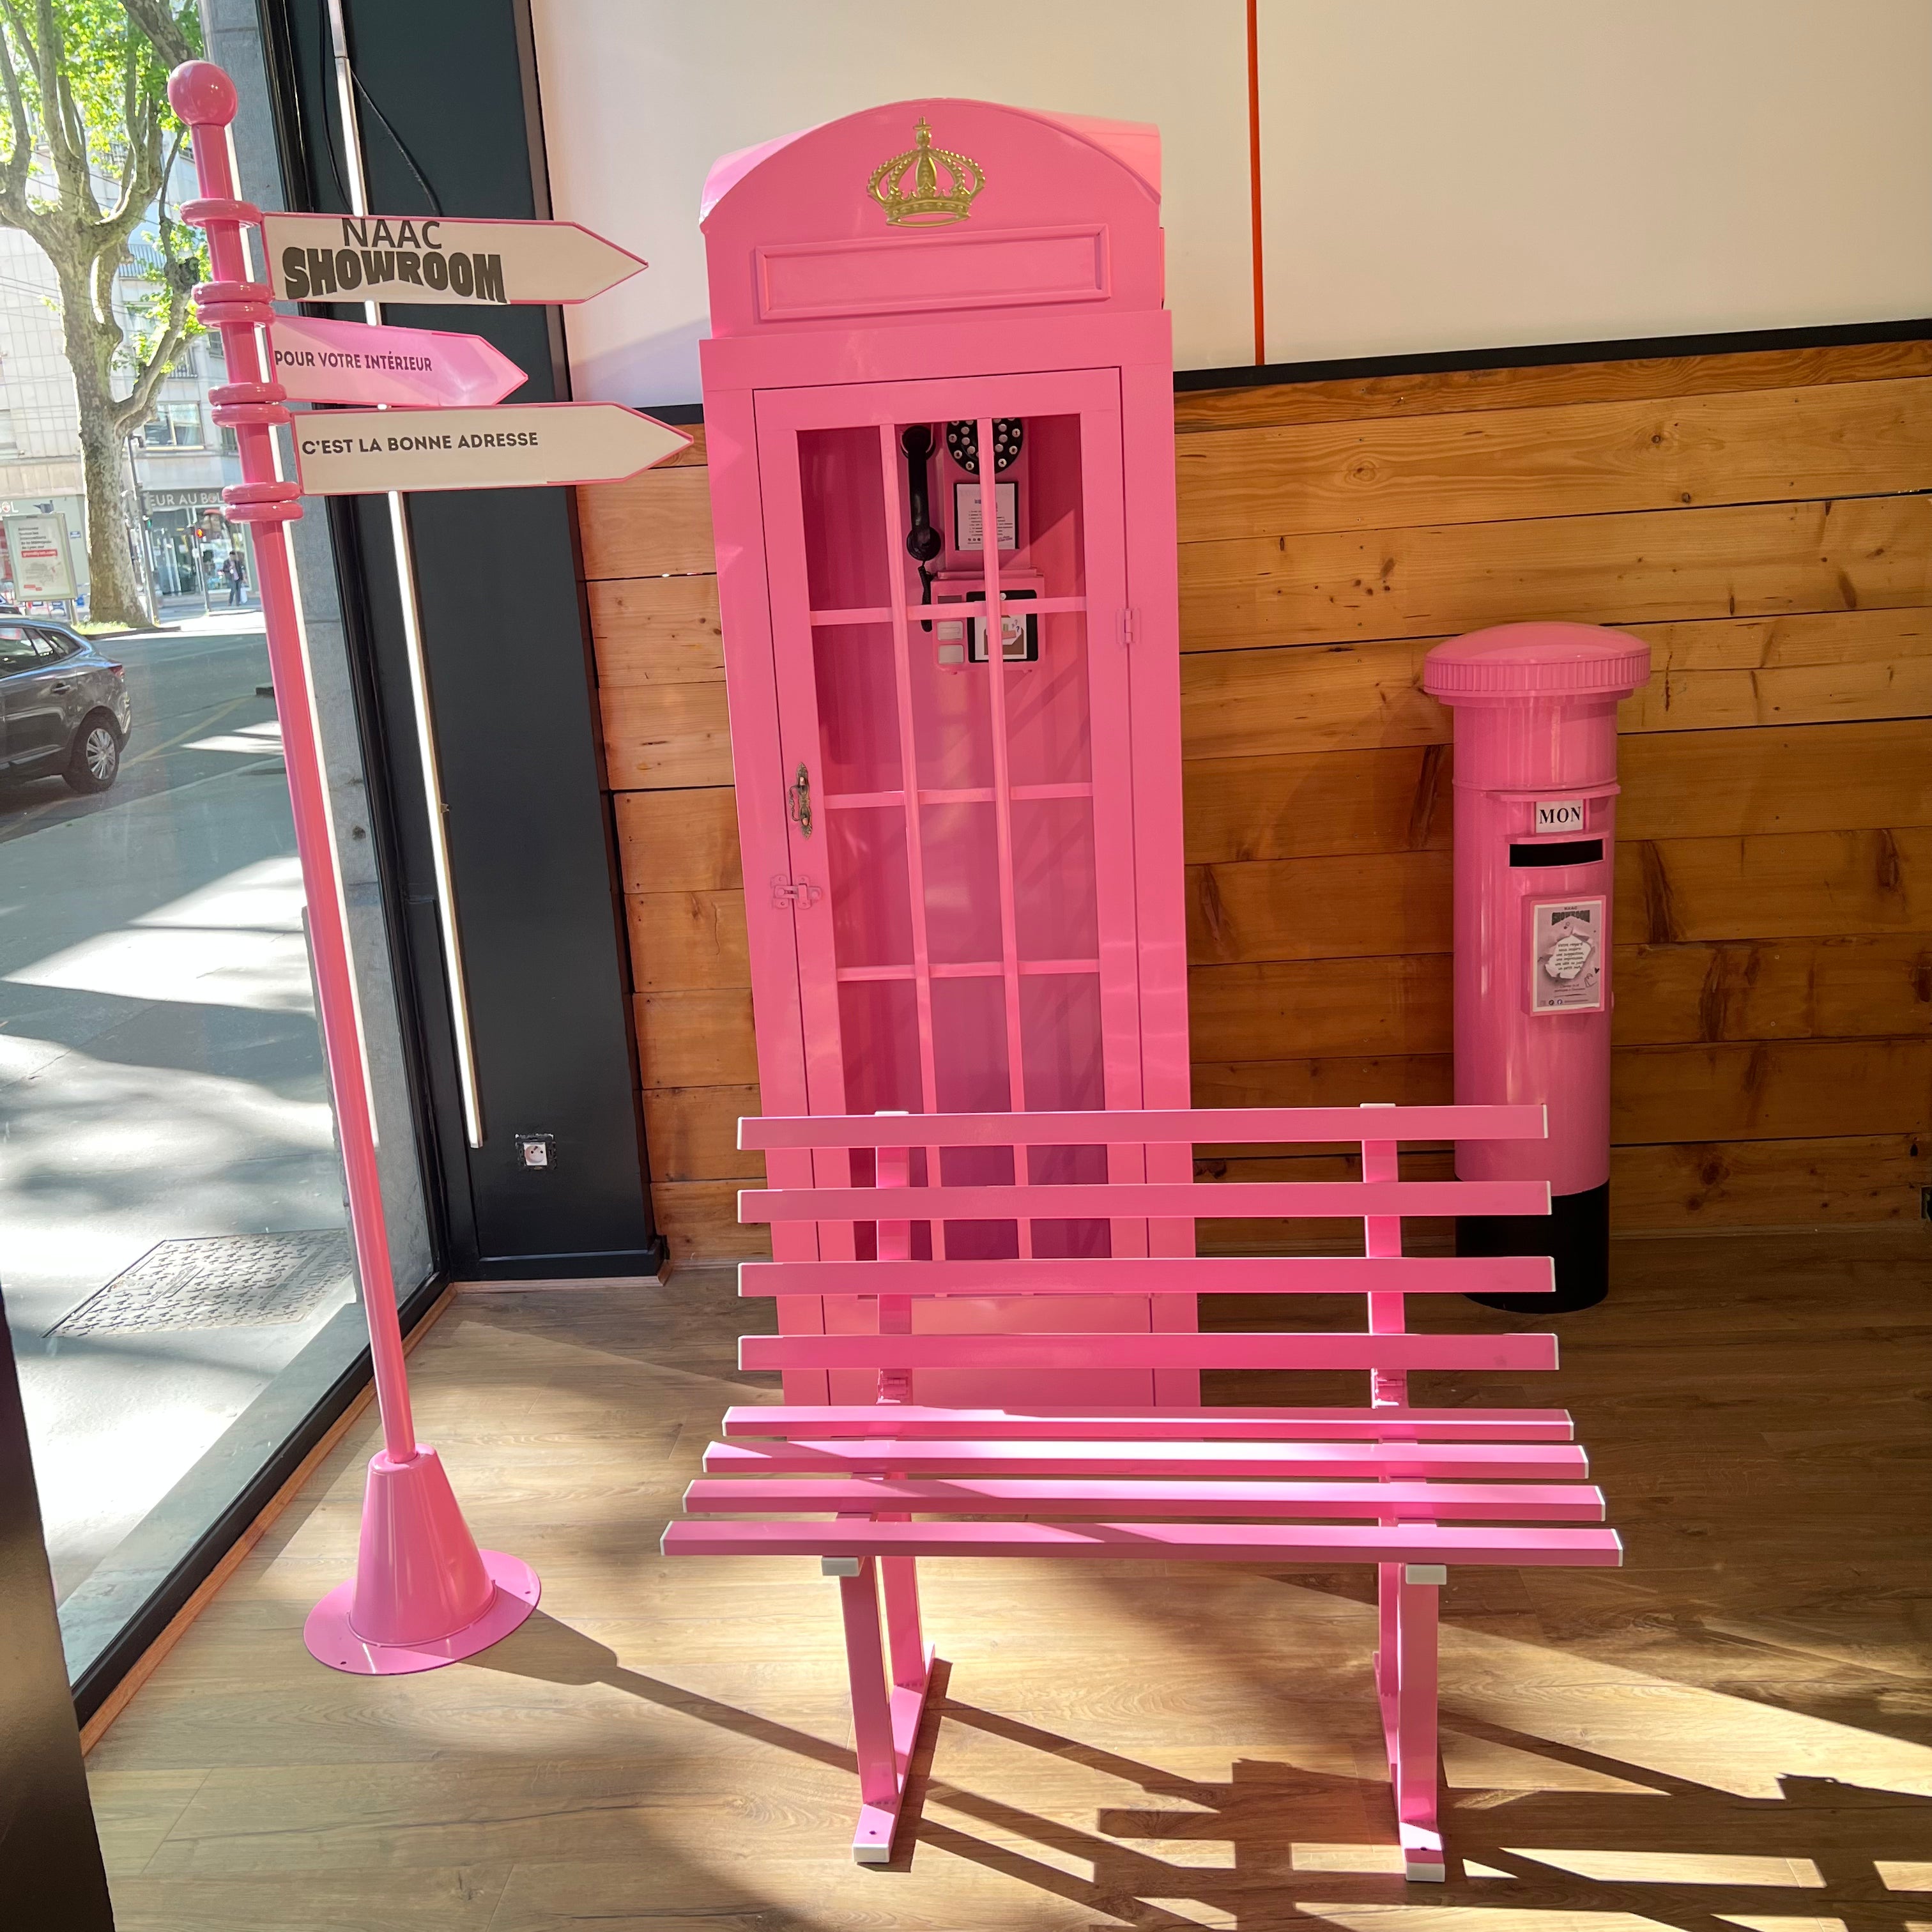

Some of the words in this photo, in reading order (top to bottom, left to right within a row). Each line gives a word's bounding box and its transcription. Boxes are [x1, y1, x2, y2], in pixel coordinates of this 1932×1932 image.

[342, 218, 442, 249] NAAC
[282, 247, 508, 304] SHOWROOM
[274, 351, 315, 366] POUR
[318, 352, 362, 368] VOTRE
[364, 351, 433, 371] INTÉRIEUR
[302, 440, 353, 455] C'EST
[359, 438, 382, 452] LA
[387, 435, 452, 451] BONNE
[458, 432, 539, 448] ADRESSE
[180, 493, 197, 505] AU
[201, 491, 225, 505] BOL
[1539, 806, 1581, 824] MON
